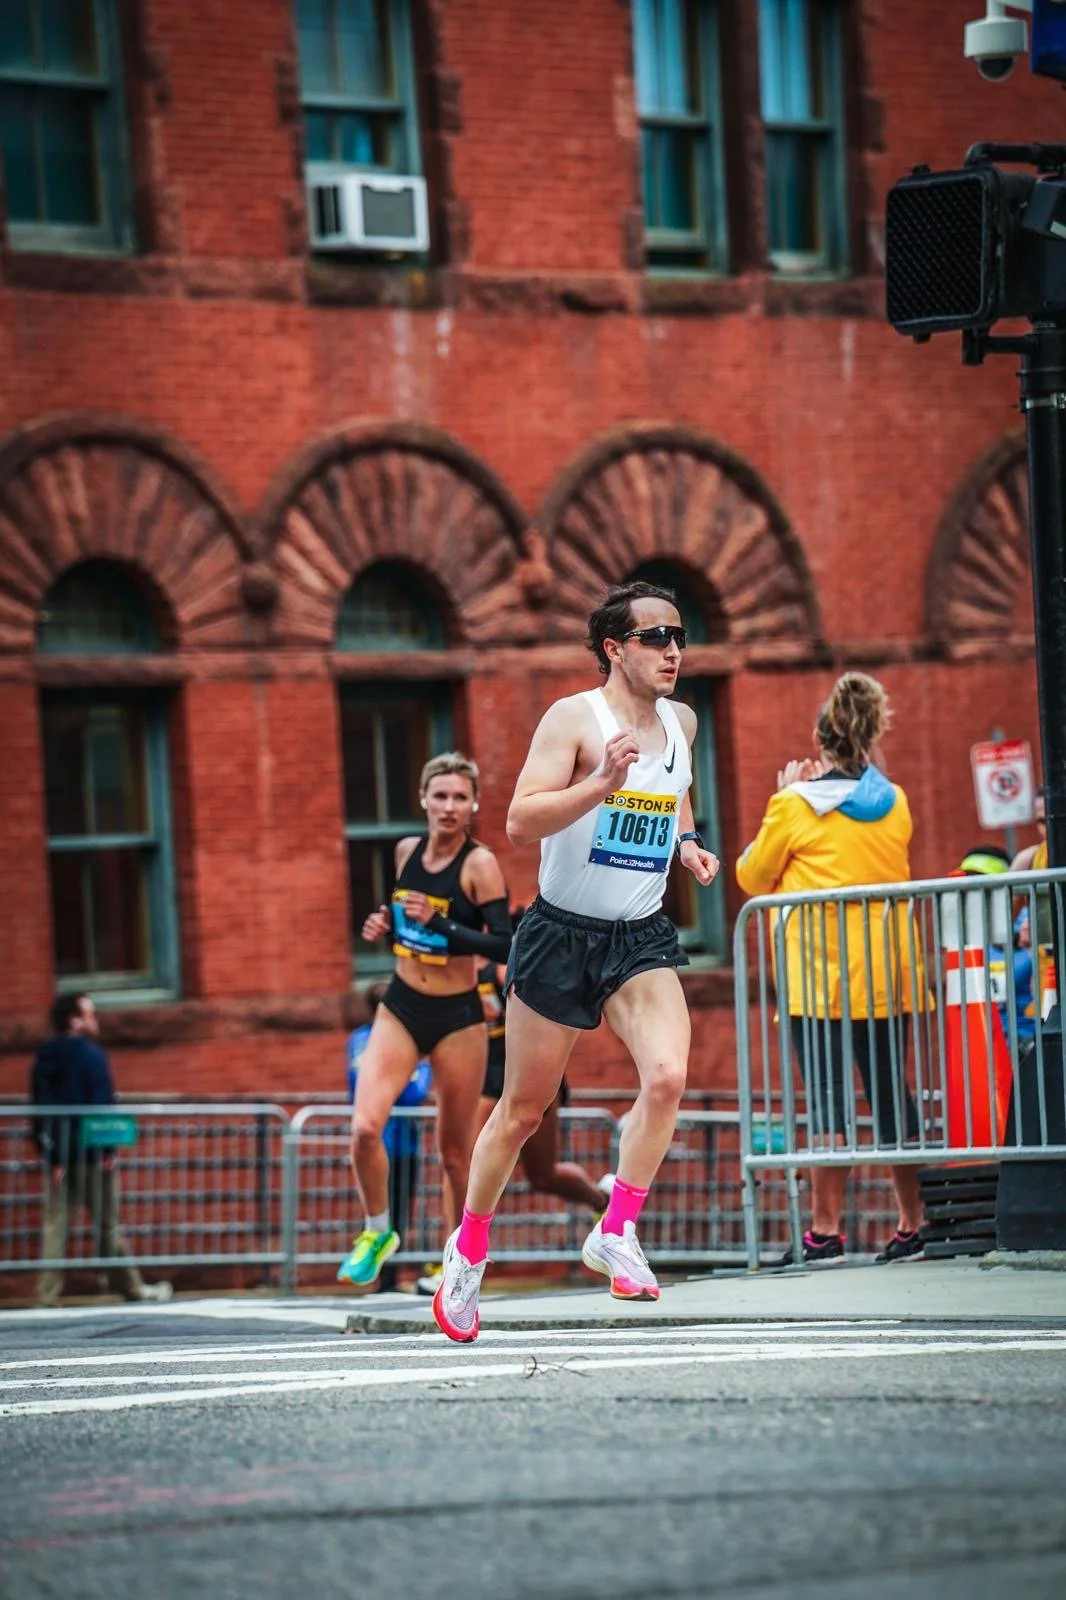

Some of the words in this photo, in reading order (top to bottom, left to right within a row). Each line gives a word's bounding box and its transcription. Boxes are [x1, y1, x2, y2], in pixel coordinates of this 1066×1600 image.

[604, 794, 662, 812] BOSTON
[664, 801, 676, 813] 5K
[608, 811, 670, 847] 10613
